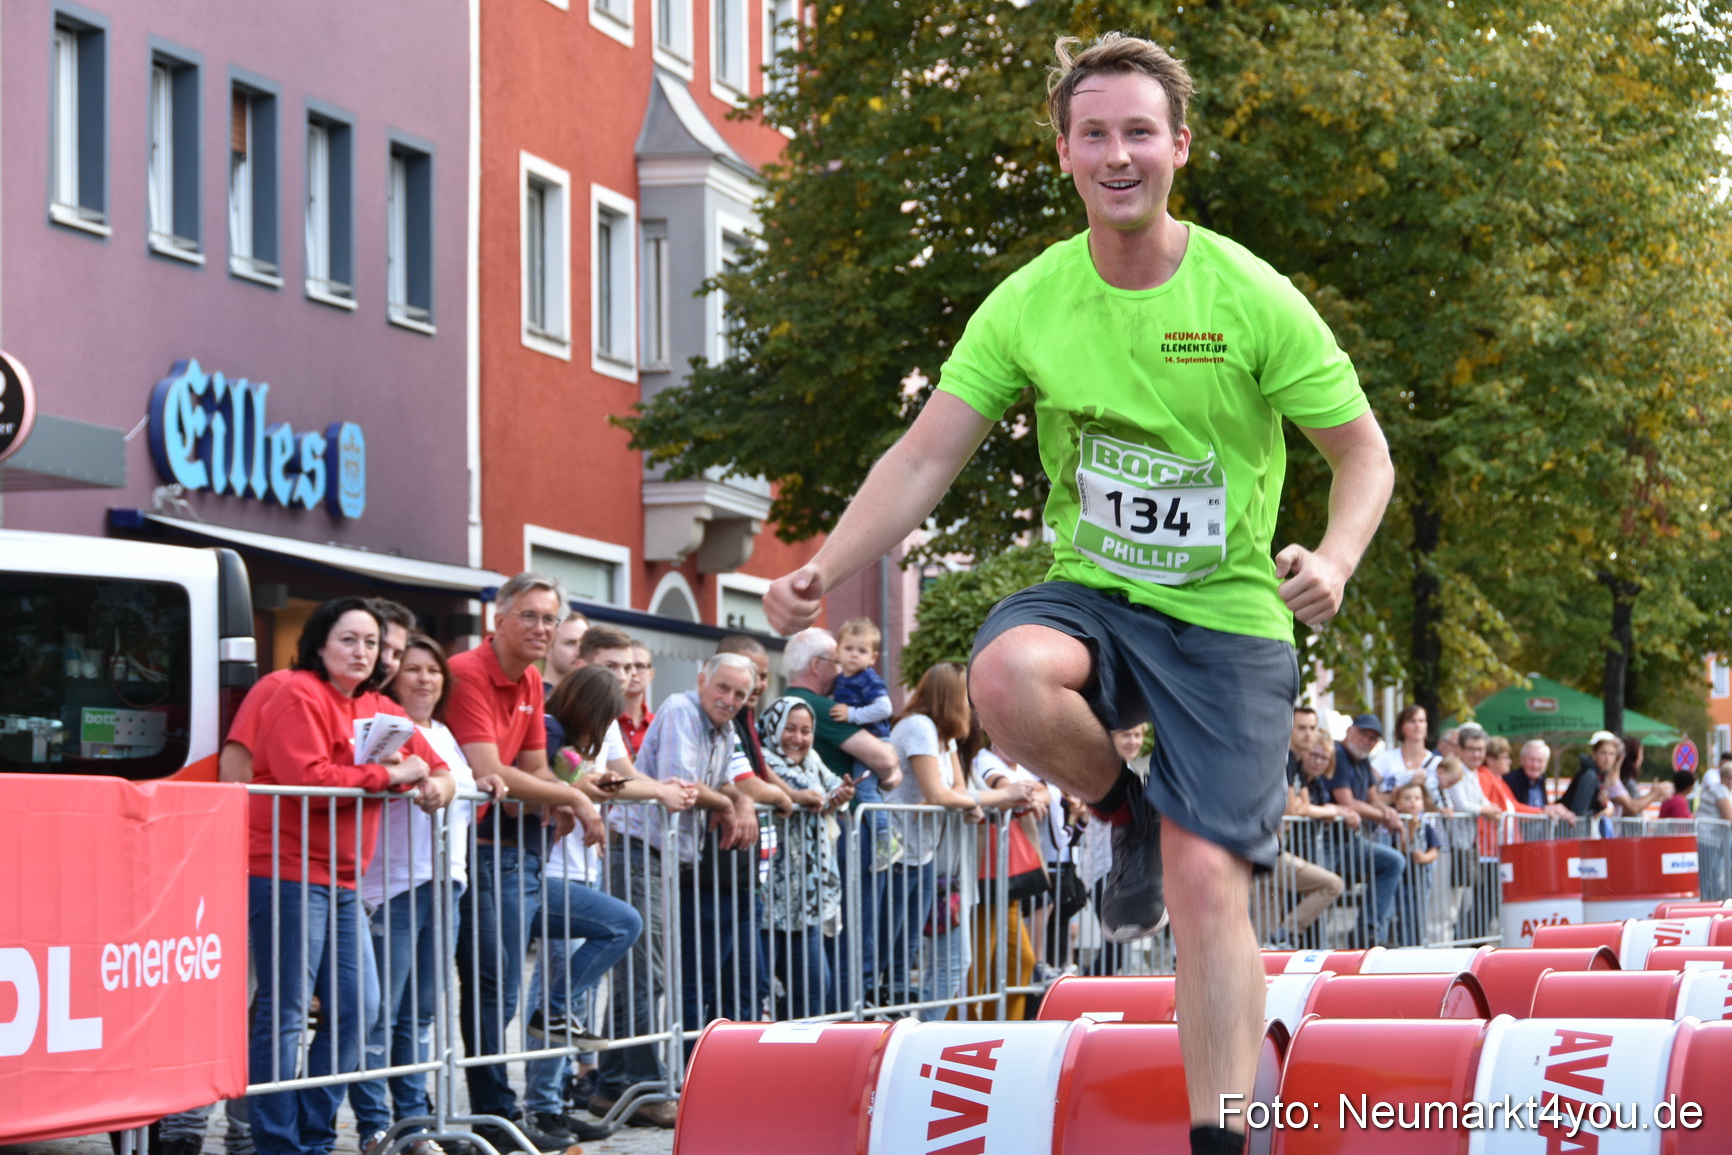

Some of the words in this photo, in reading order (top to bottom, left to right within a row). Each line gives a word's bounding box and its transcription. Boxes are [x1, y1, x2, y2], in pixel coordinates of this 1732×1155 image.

[163, 357, 328, 511] Eilles
[1091, 439, 1215, 488] BOCK
[1105, 490, 1191, 537] 134
[1208, 498, 1220, 506] E6
[1101, 535, 1190, 569] PHILLIP
[84, 711, 116, 725] bott
